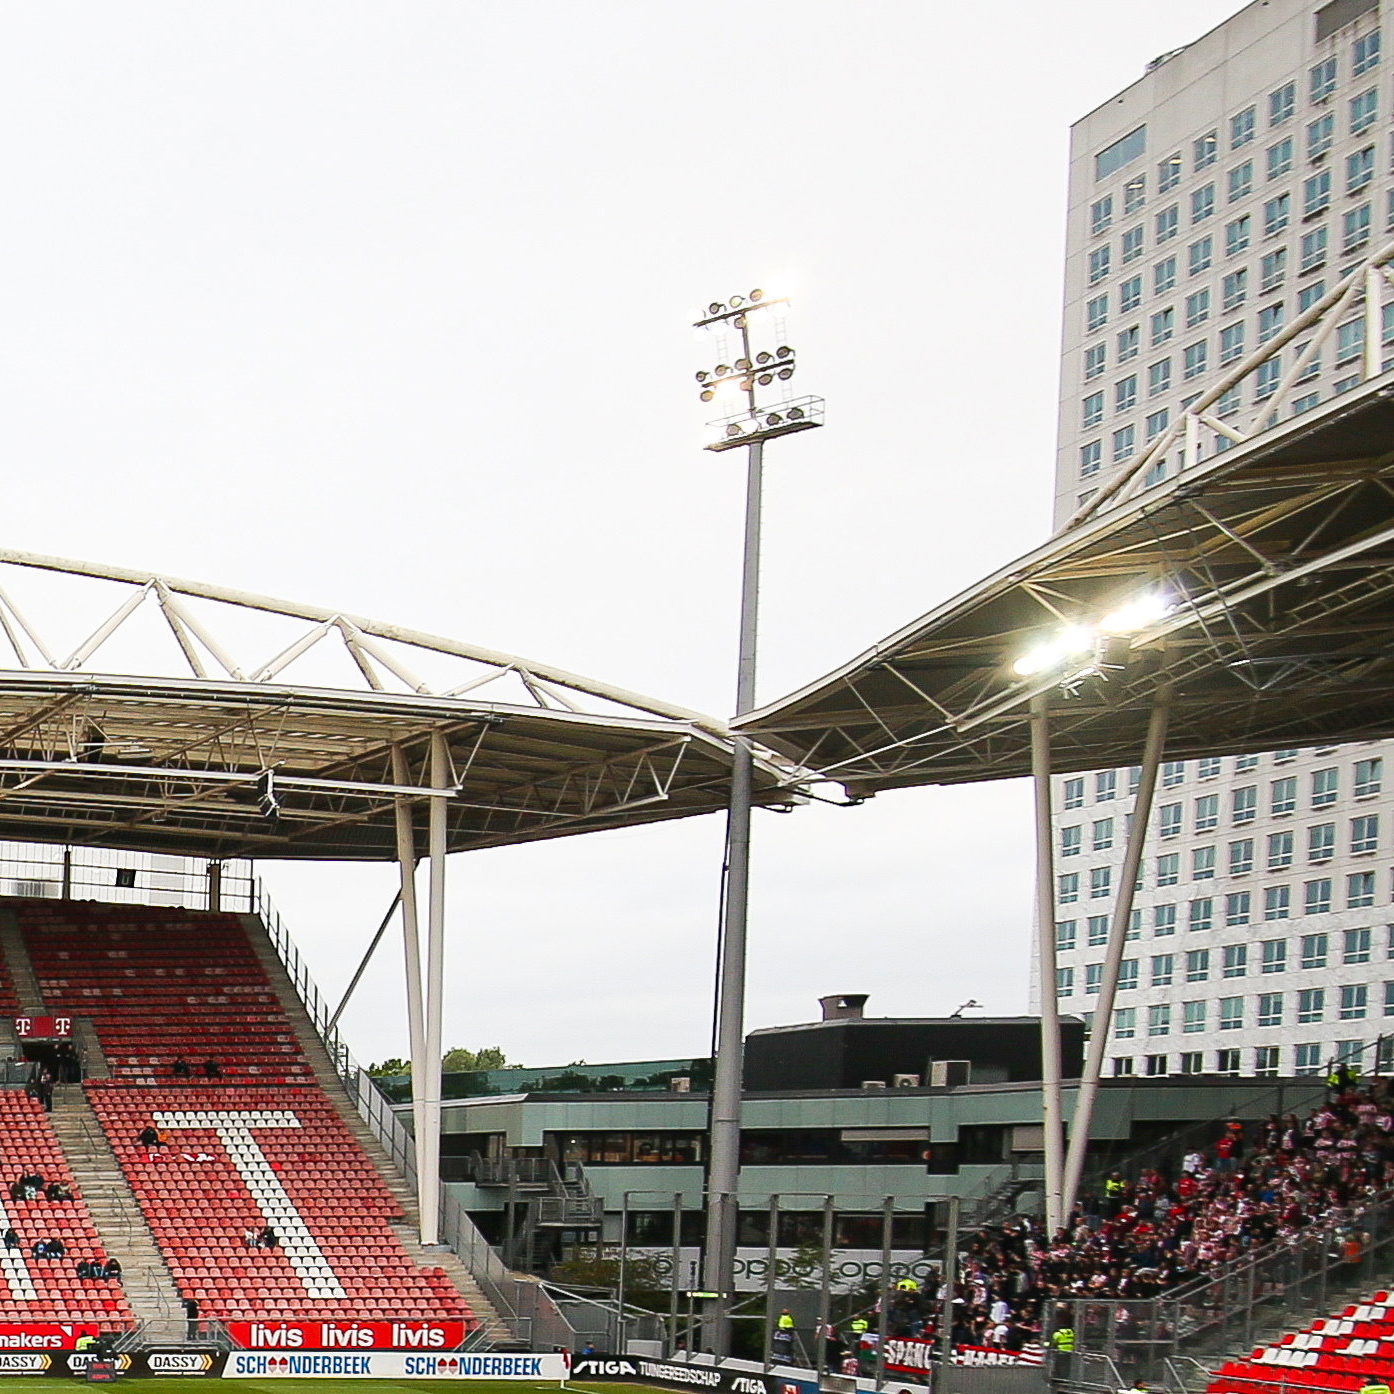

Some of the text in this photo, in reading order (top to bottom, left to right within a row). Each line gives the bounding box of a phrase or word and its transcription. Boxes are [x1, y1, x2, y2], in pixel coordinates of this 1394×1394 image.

[250, 1324, 304, 1347] livis
[321, 1324, 374, 1347] livis
[392, 1324, 445, 1347] livis
[155, 1356, 197, 1368] DASSY
[574, 1361, 636, 1376] STIGA
